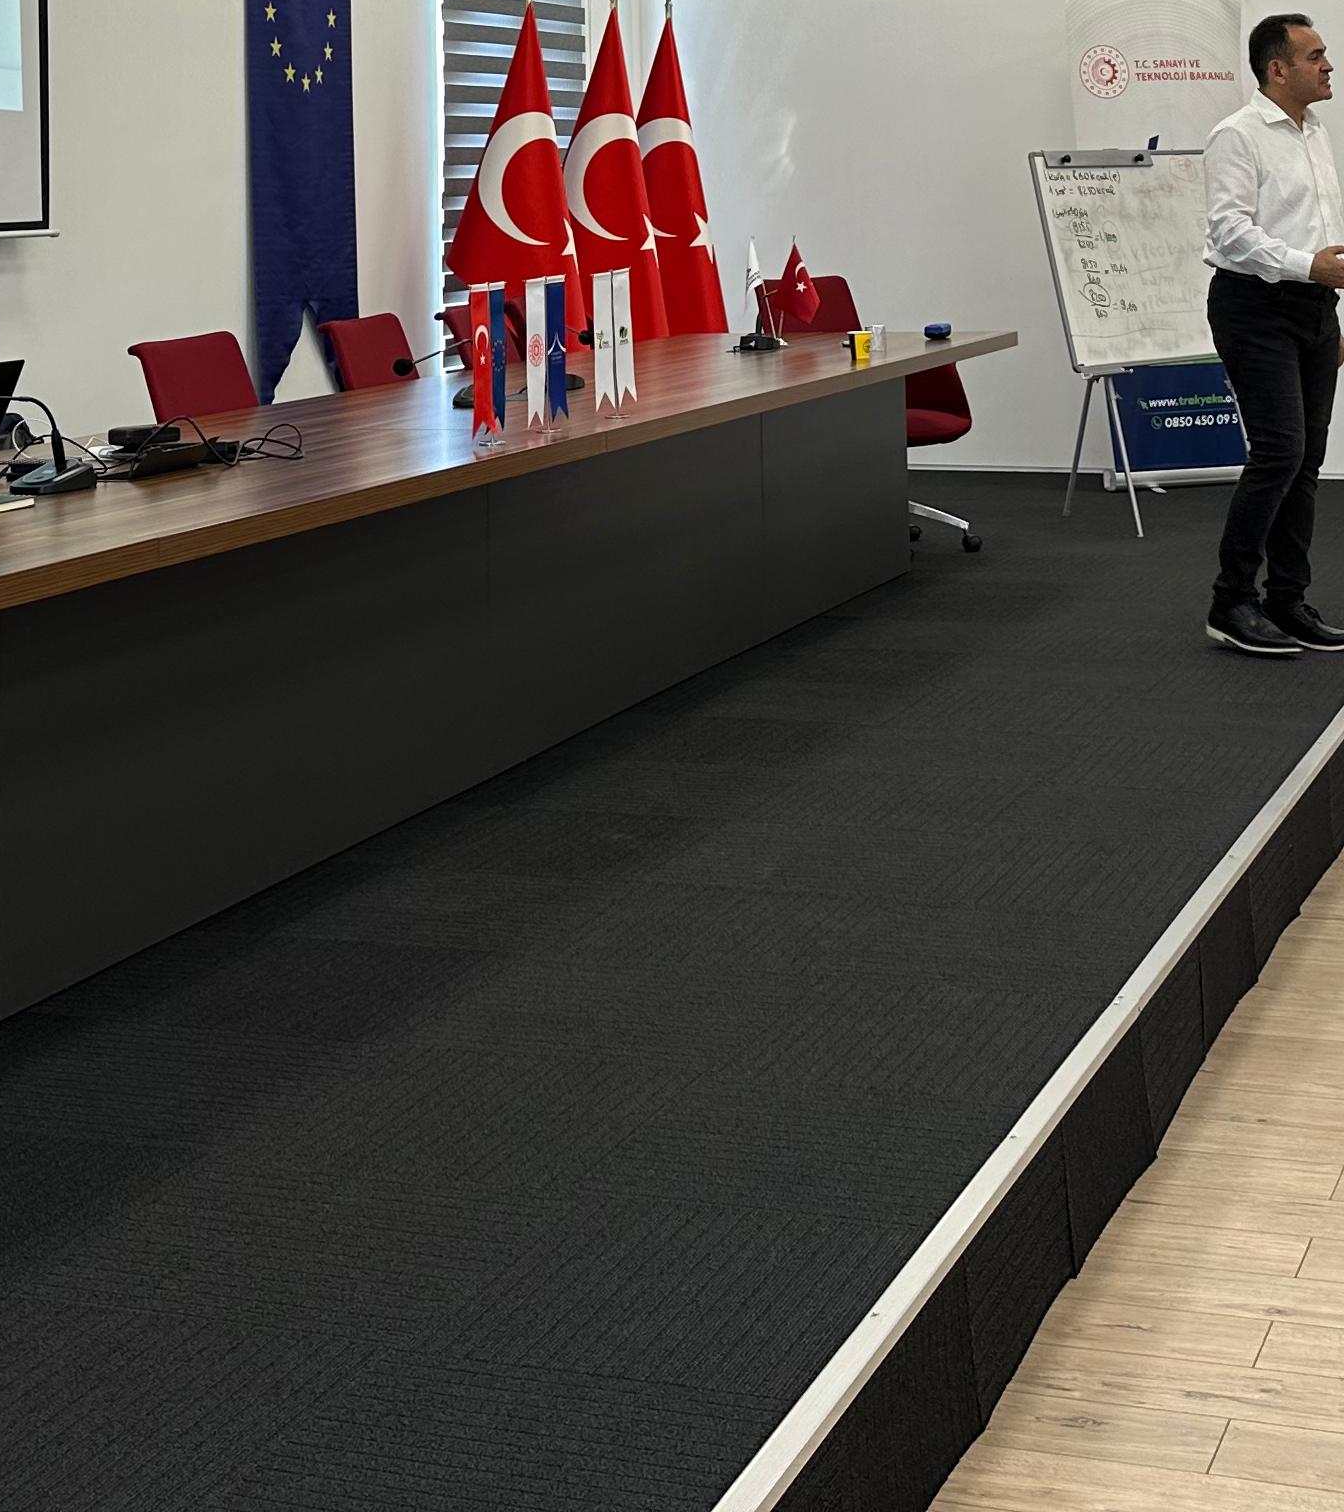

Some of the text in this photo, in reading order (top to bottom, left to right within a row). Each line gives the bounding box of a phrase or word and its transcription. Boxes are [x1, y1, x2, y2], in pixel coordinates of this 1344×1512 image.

[1134, 58, 1201, 69] T.C. SANAYİ VE
[1135, 70, 1188, 81] TEKNOLOJİ
[1148, 394, 1234, 408] www.trakyaka.o
[1165, 416, 1193, 428] 0850
[1194, 414, 1215, 426] 450
[1216, 413, 1231, 425] 09
